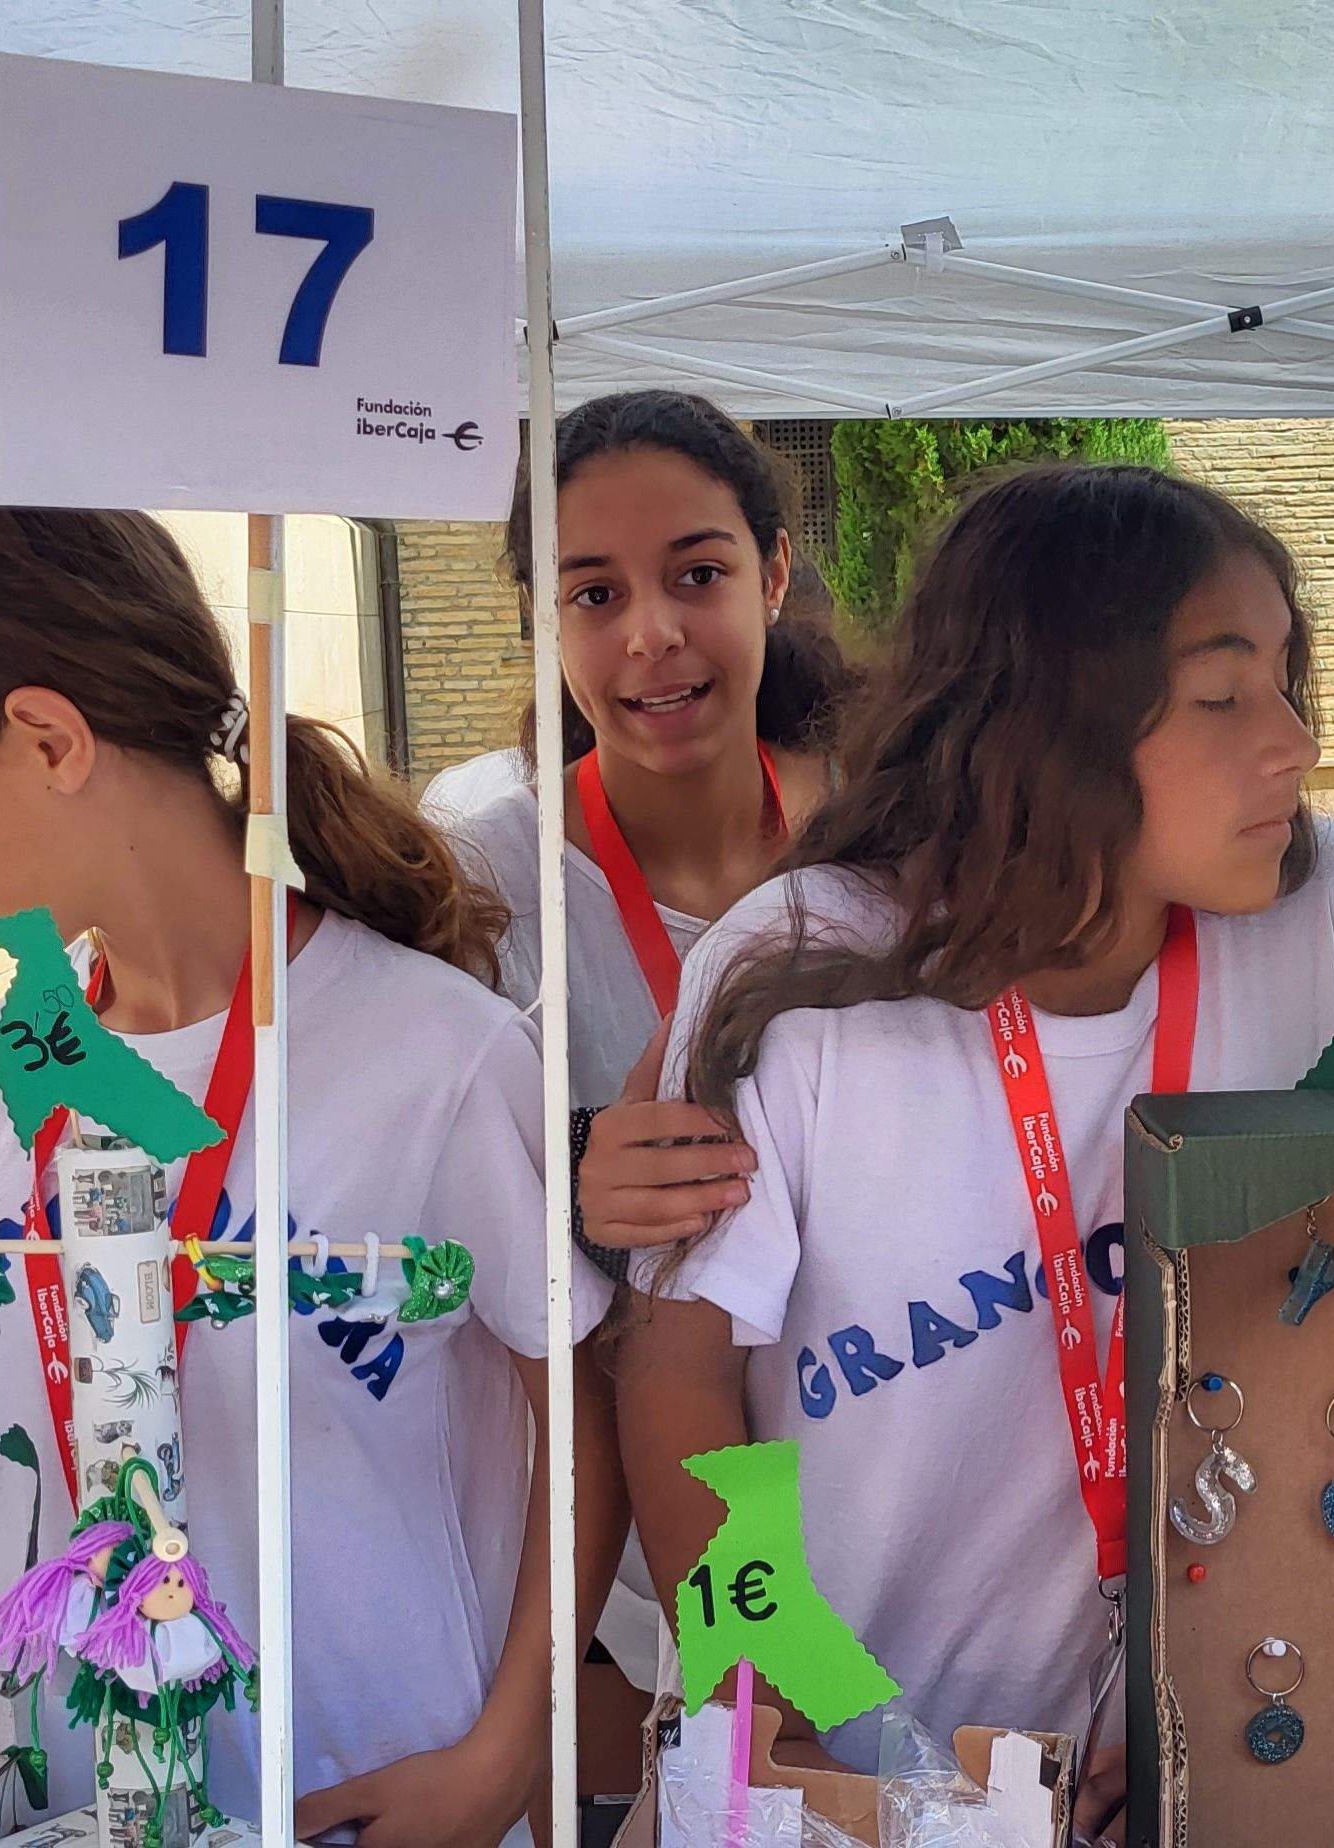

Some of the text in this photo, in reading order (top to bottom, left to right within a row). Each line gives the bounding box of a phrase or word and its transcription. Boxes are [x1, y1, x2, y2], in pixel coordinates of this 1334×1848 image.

[118, 181, 375, 368] 17
[356, 397, 432, 418] Fundación
[356, 418, 436, 444] iberCaja
[1037, 1111, 1060, 1173] Fundación
[1066, 1247, 1084, 1308] Fundación
[49, 1283, 68, 1342] Fundación
[1103, 1417, 1118, 1479] Fundación
